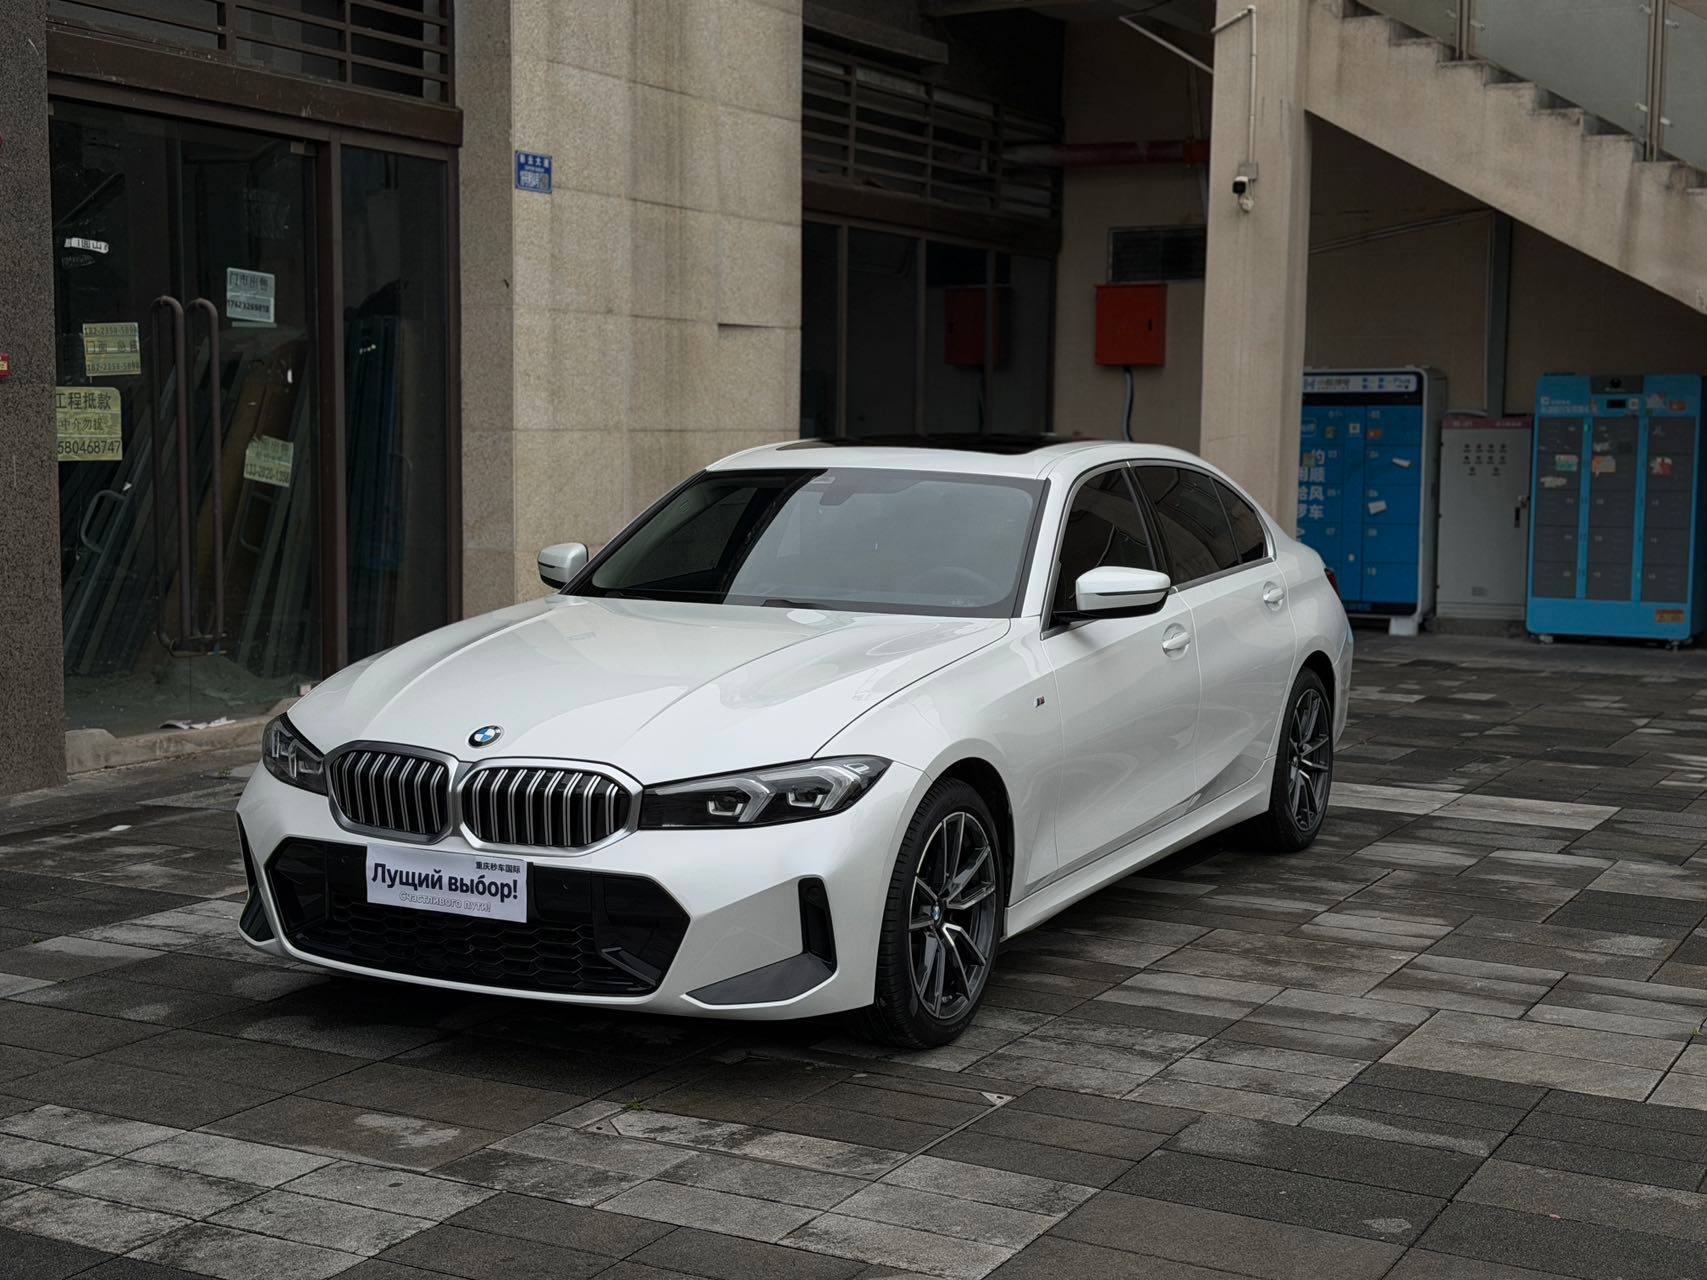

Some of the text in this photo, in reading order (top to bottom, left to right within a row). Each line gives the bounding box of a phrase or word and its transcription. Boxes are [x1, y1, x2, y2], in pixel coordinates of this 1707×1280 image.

[56, 392, 111, 410] 工程抵款
[475, 861, 521, 874] 重庆秒车国际
[371, 862, 518, 903] Лущий выбор!
[400, 891, 462, 909] Счастливого
